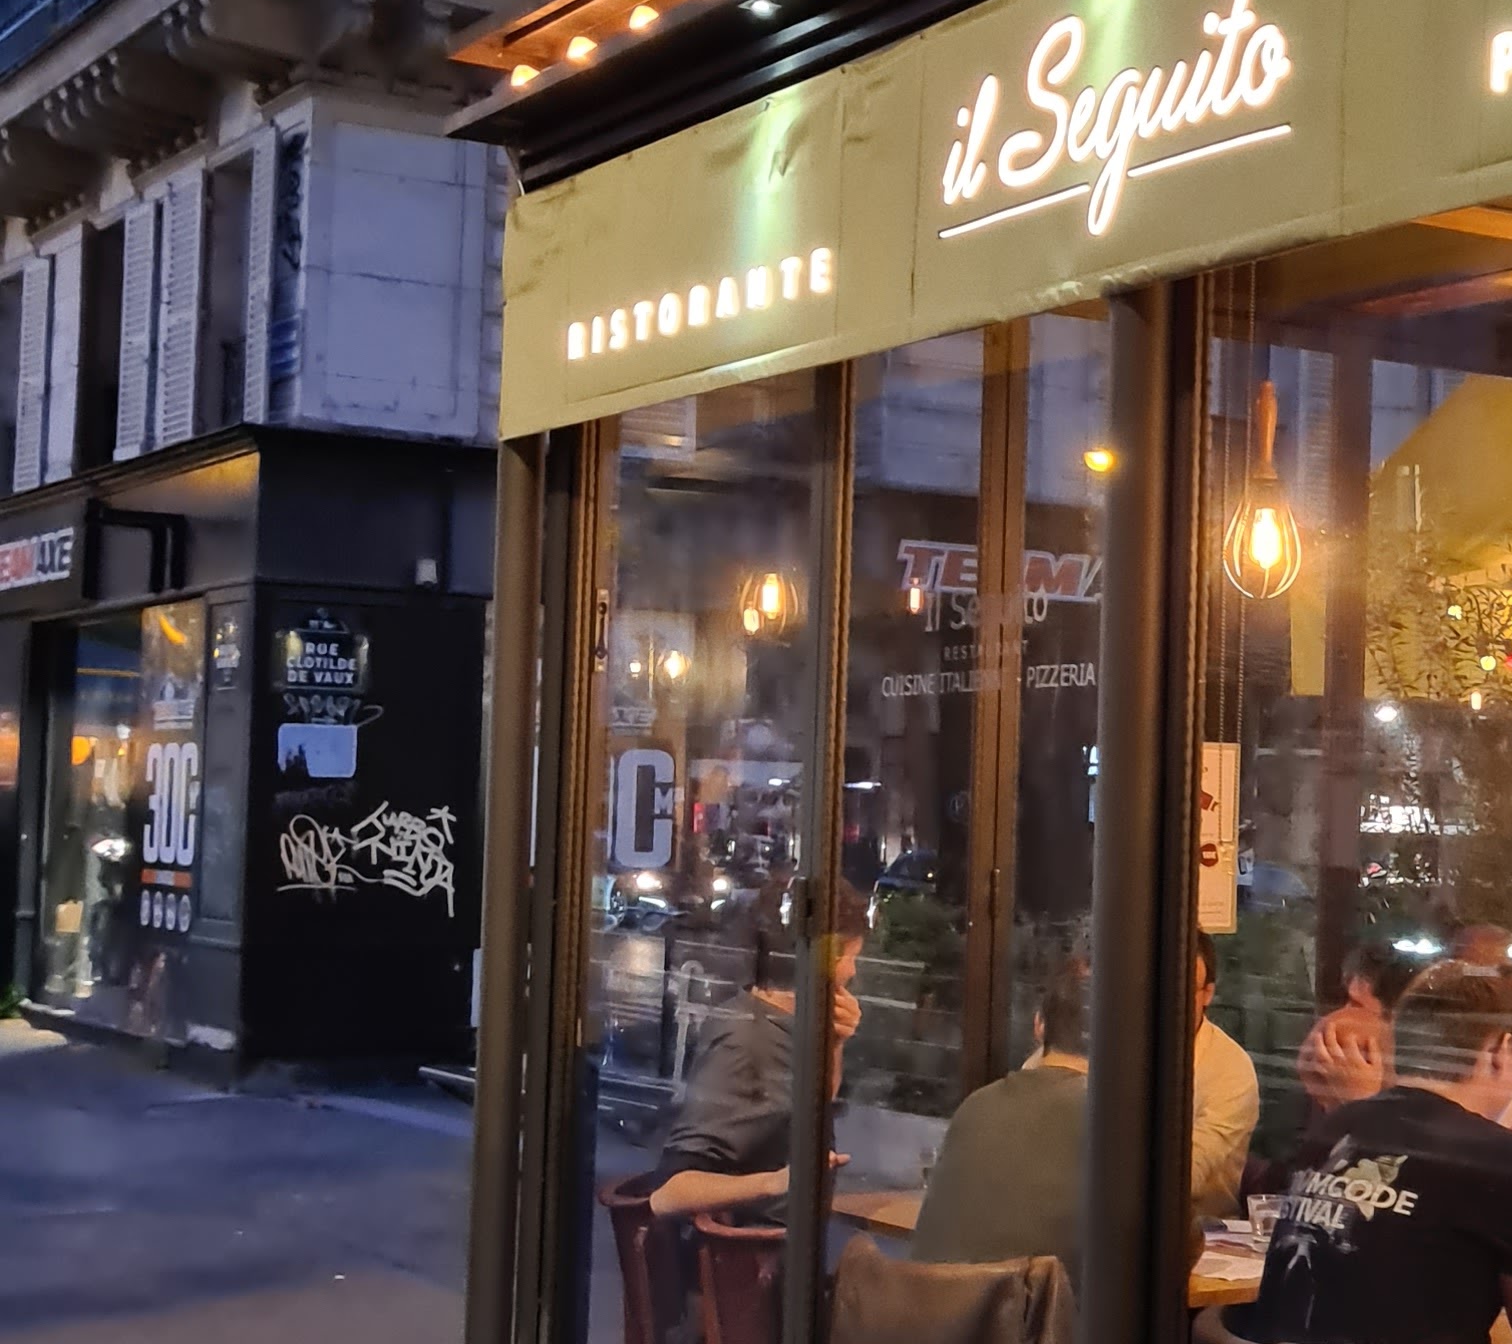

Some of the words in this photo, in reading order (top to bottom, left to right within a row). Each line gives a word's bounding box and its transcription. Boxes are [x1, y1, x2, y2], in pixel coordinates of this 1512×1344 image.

[941, 73, 999, 206] il
[565, 246, 834, 362] RISTORANTE
[305, 642, 340, 656] RUE
[286, 655, 357, 671] CLOTILDE
[287, 669, 309, 683] DE
[313, 670, 355, 685] VAUX
[882, 673, 935, 697] CUISINE
[1026, 662, 1097, 689] PIZZERIA
